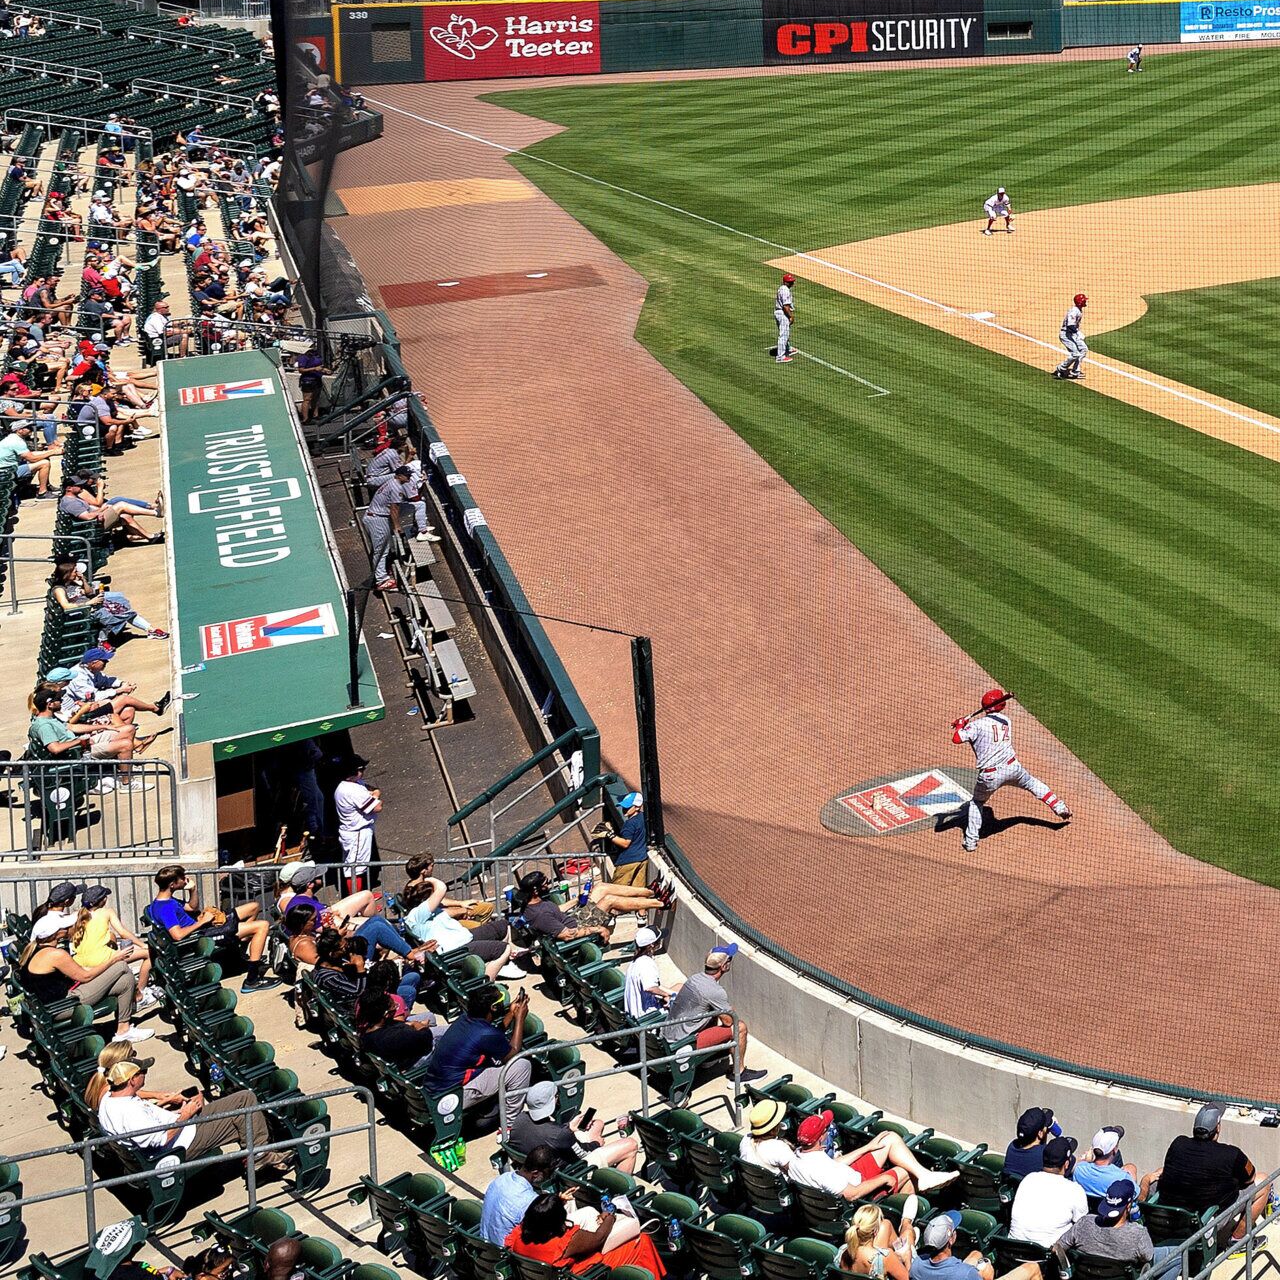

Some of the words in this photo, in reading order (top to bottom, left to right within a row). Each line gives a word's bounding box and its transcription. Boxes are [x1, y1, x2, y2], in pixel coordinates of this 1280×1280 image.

[349, 11, 368, 20] 330
[504, 15, 594, 36] Harris
[777, 22, 868, 56] CPI
[871, 18, 973, 52] SECURITY
[504, 38, 592, 58] Teeter
[204, 424, 273, 483] TRUIST
[214, 505, 291, 568] FIELD
[991, 724, 1010, 743] 12
